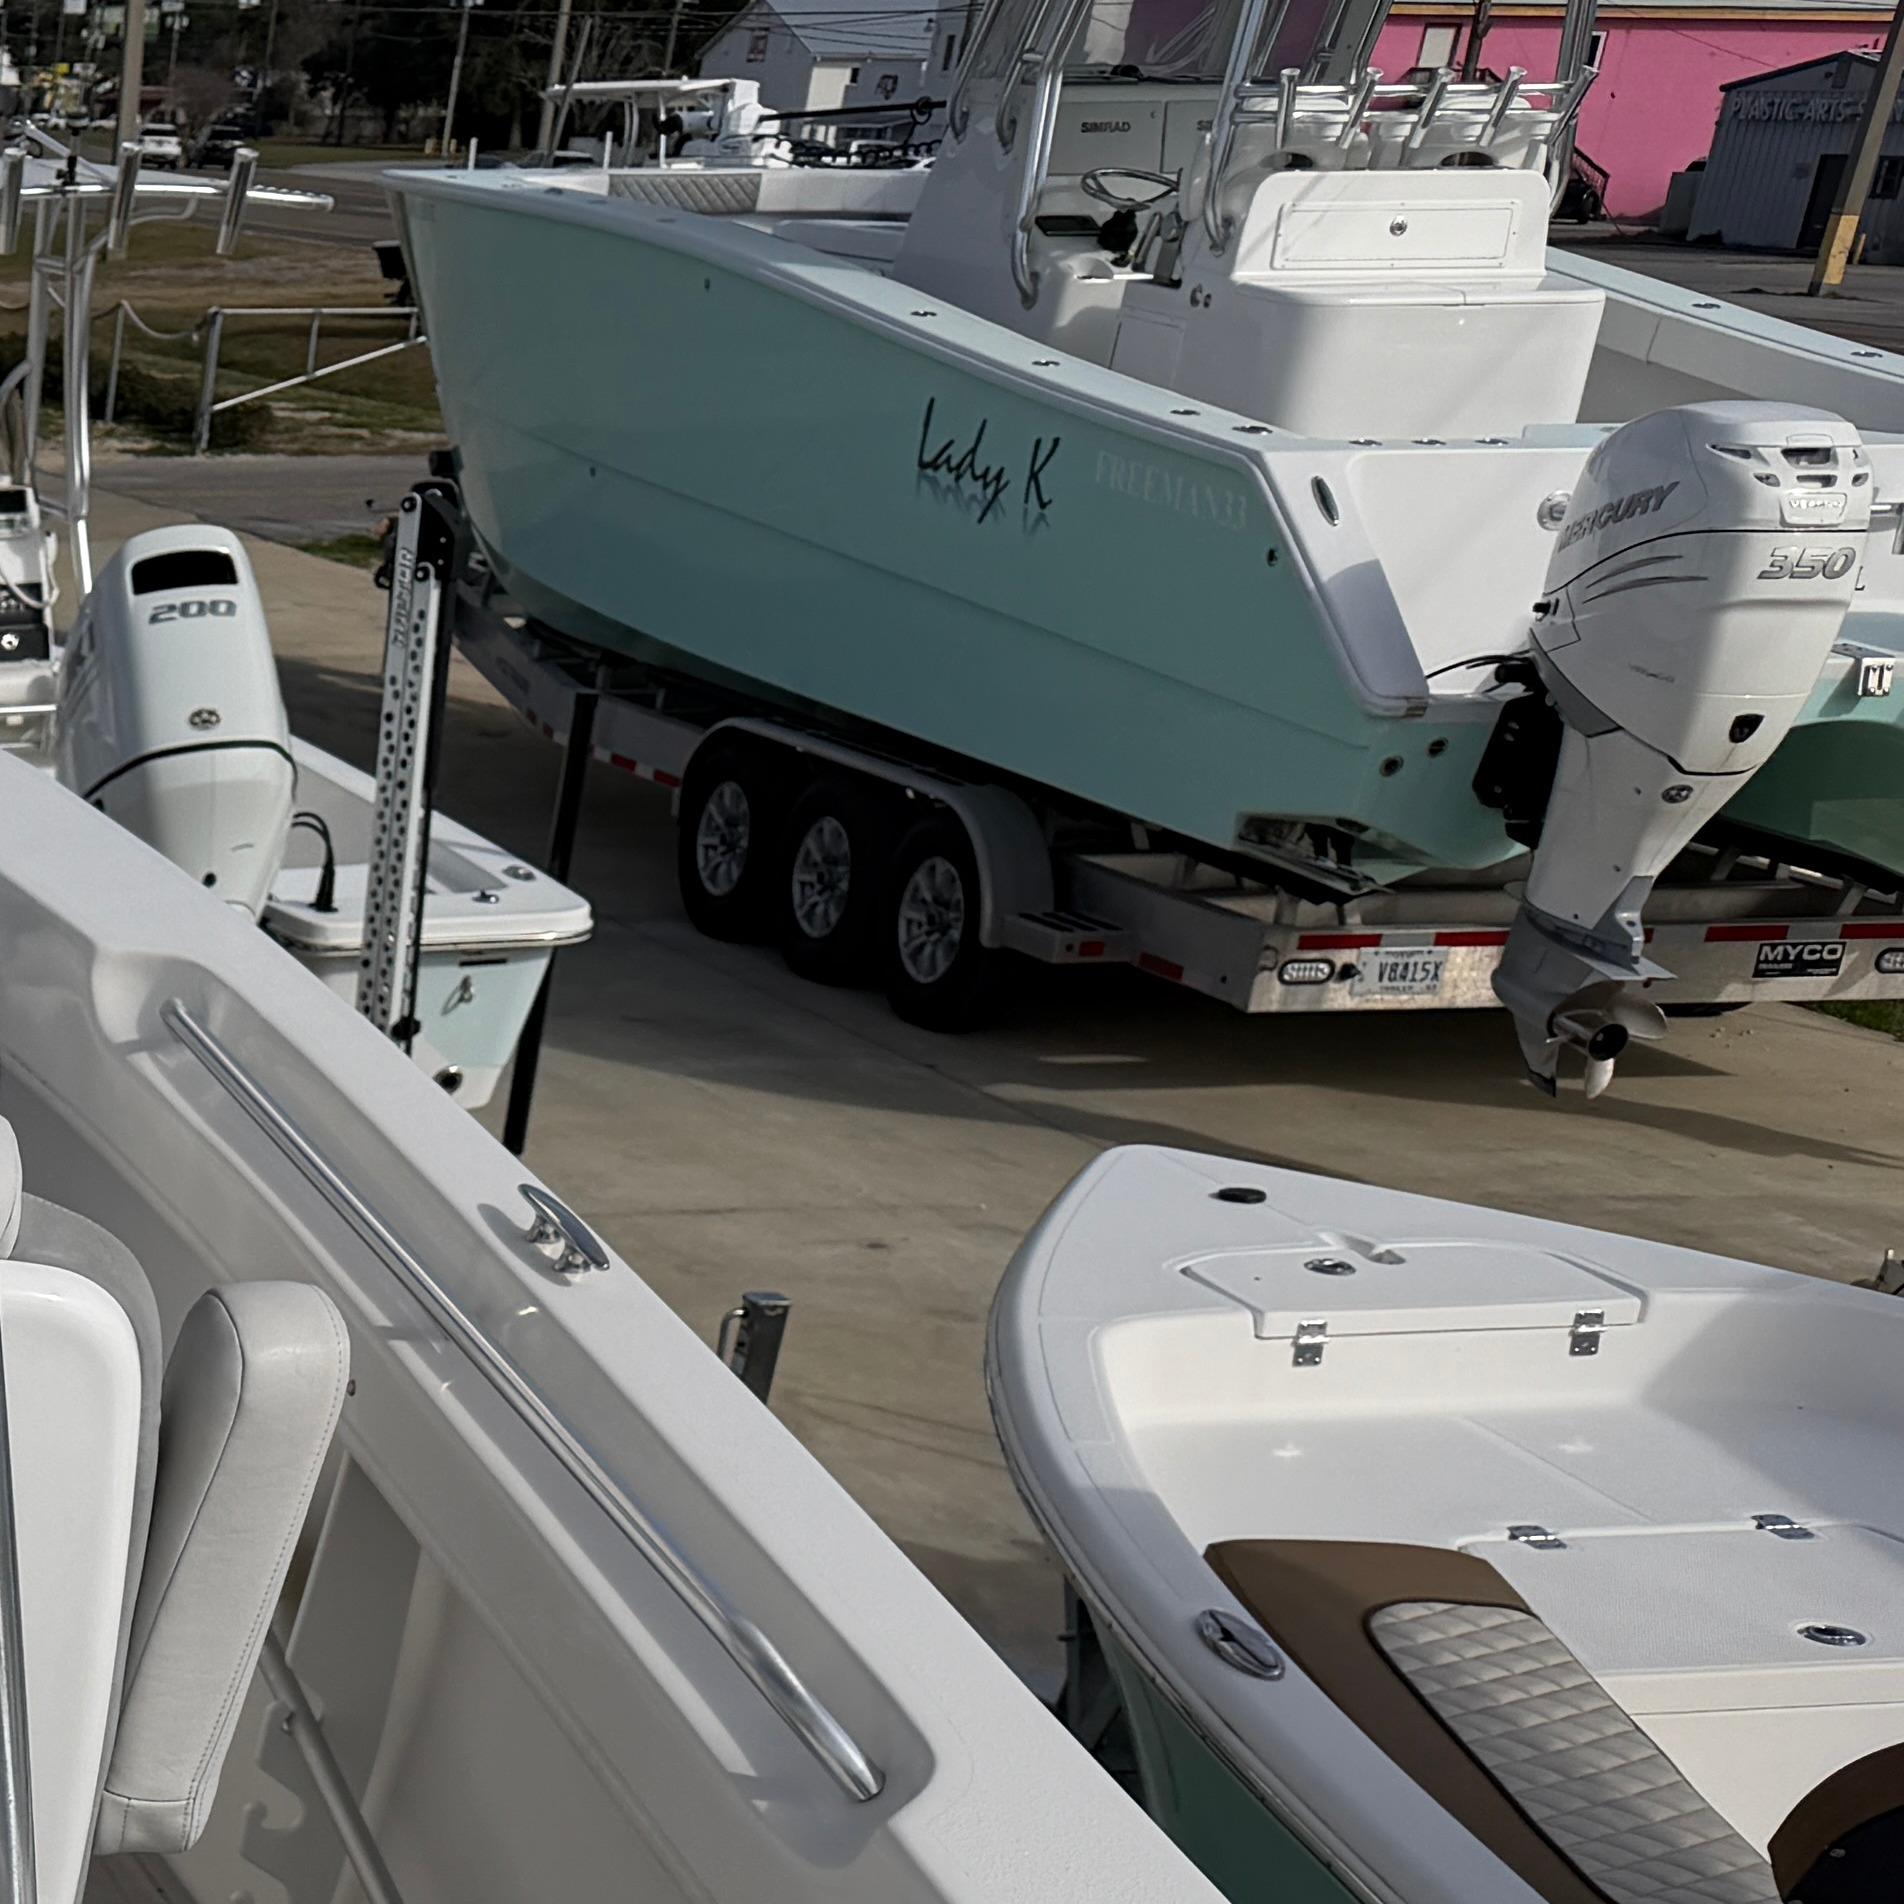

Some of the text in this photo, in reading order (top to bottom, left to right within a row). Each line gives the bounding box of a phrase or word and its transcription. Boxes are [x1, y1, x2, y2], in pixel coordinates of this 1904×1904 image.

[1080, 120, 1132, 133] SIMRAD
[917, 397, 1061, 525] Lady K
[1558, 480, 1681, 554] MERCURY
[1756, 546, 1857, 581] 350
[147, 599, 238, 625] 200
[1759, 944, 1844, 961] MYCO
